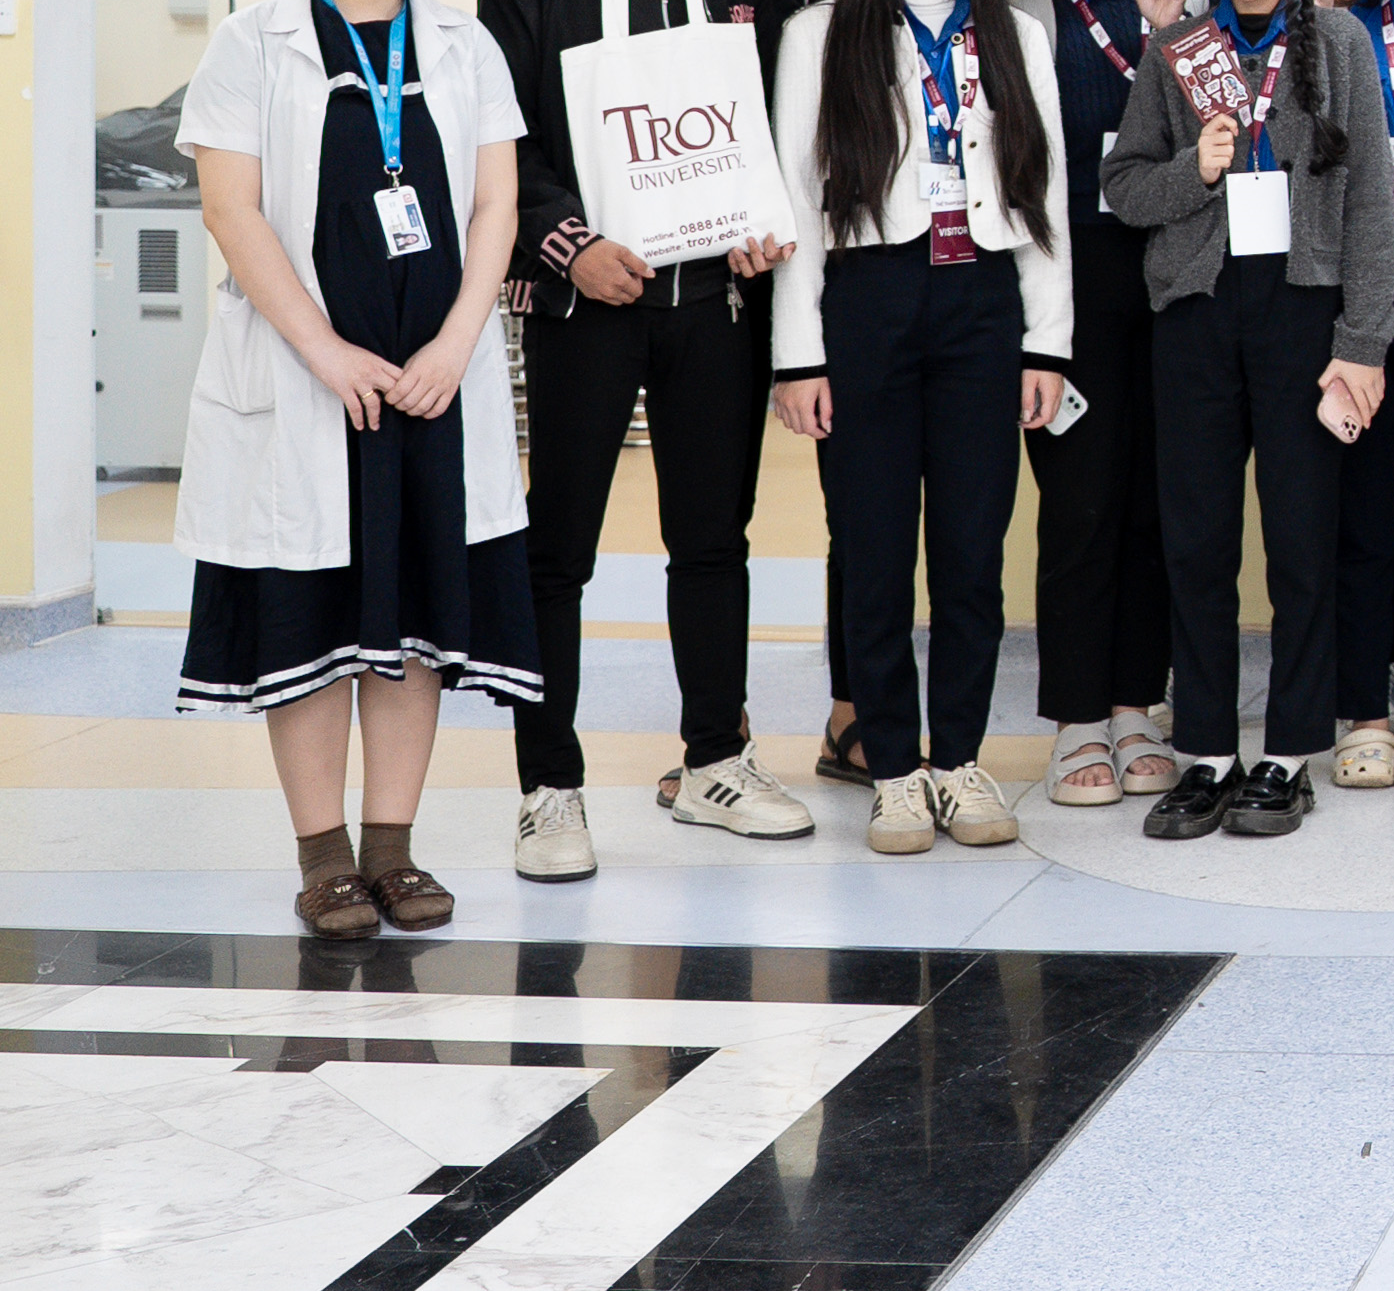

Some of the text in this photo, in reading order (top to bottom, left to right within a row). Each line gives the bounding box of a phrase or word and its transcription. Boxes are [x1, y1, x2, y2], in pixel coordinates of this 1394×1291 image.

[602, 100, 740, 165] TROY
[629, 152, 743, 192] UNIVERSITY
[679, 219, 713, 235] 0888
[402, 876, 420, 884] VIP
[334, 884, 352, 894] VIP
